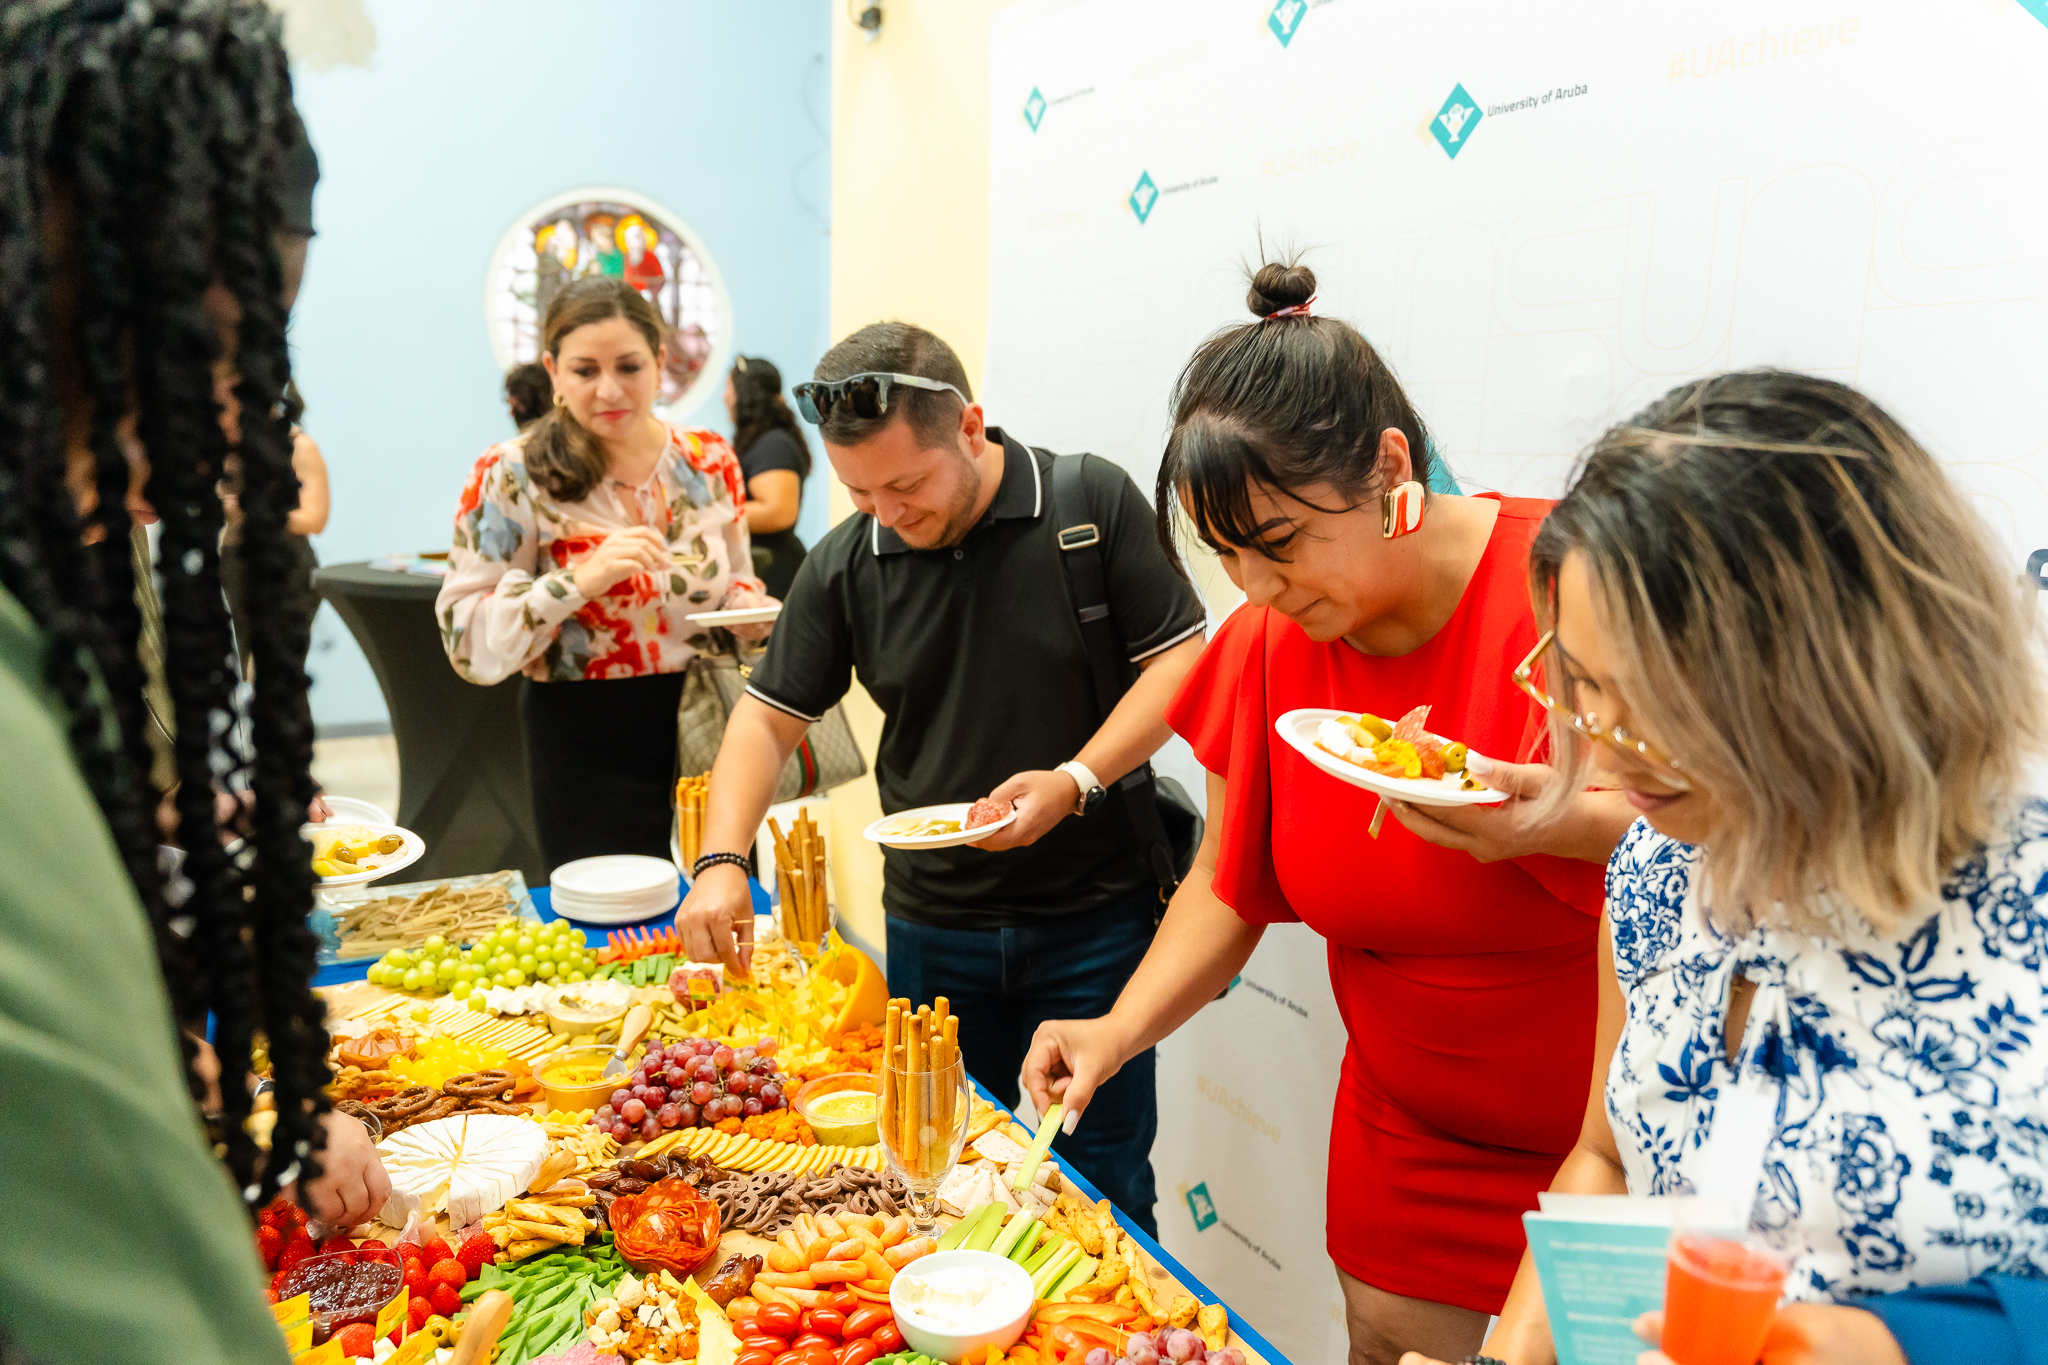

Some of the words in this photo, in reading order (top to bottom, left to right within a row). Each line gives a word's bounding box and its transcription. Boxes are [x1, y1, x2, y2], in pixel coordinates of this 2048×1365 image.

[1666, 16, 1860, 84] #UAchieve
[1487, 96, 1540, 117] University
[1541, 89, 1553, 104] of
[1555, 84, 1588, 101] Aruba
[1261, 139, 1360, 179] #UAchieve
[1244, 976, 1277, 1003] University
[1287, 999, 1308, 1018] Aruba
[1197, 1074, 1281, 1145] #UAchieve
